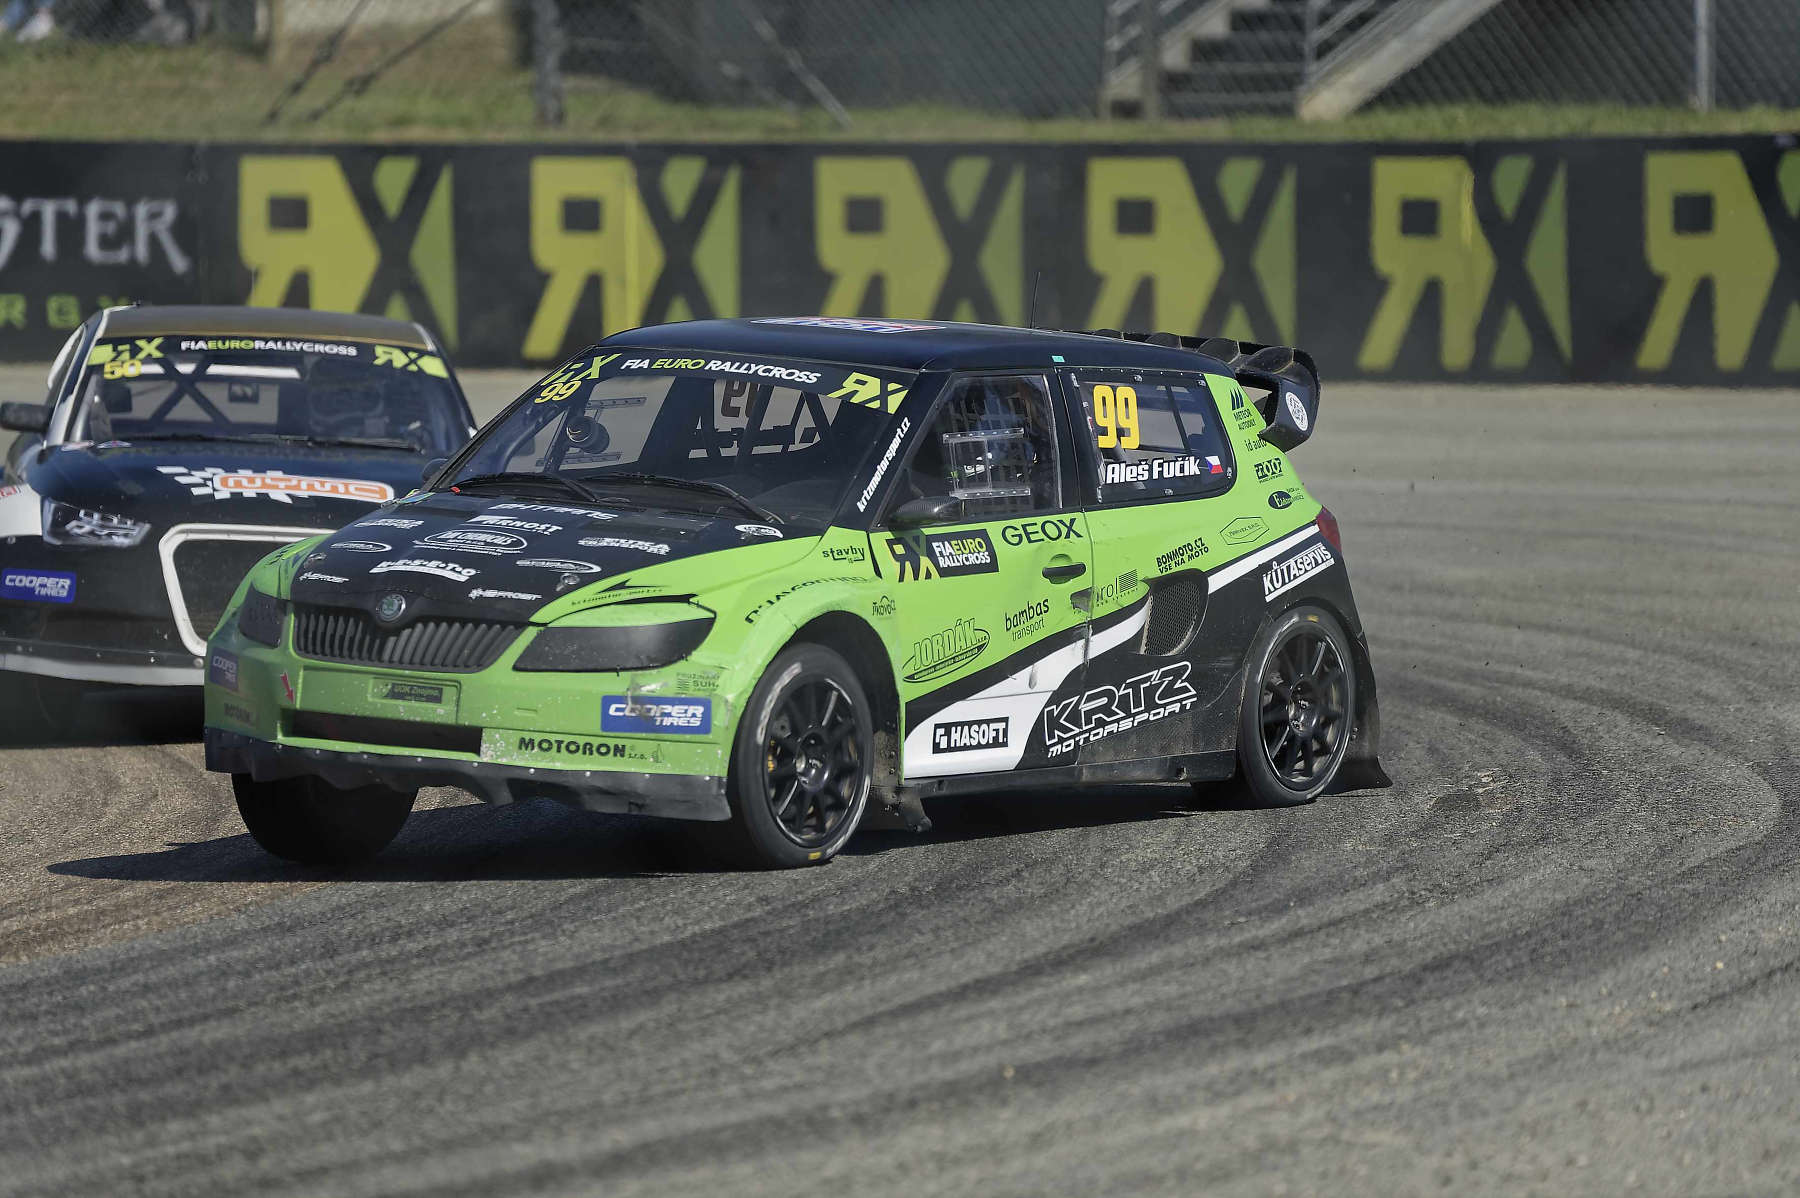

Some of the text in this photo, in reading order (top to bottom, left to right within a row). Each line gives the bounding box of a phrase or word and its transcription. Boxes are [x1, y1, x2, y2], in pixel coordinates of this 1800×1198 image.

[103, 359, 143, 380] 50
[619, 358, 822, 385] FIA EURO RALLYCROSS
[534, 380, 583, 405] 99
[1093, 384, 1140, 450] 99
[1106, 456, 1201, 484] Aleš Fučík
[1001, 517, 1084, 547] GEOX
[822, 545, 866, 562] stavby
[938, 551, 991, 569] RALLYCROSS
[1155, 537, 1206, 568] BONMOTO.CZ
[1158, 546, 1209, 575] VSE NA MOTO
[4, 574, 72, 589] COOPER
[34, 586, 69, 599] TIRES
[1004, 598, 1050, 632] bambas
[1011, 617, 1046, 642] transport
[912, 617, 977, 672] JORDÁK
[608, 703, 705, 719] COOPER
[1044, 660, 1198, 747] KRTZ
[654, 717, 702, 727] TIRES
[1047, 697, 1198, 758] MOTORSPORT
[518, 737, 626, 759] MOTORON
